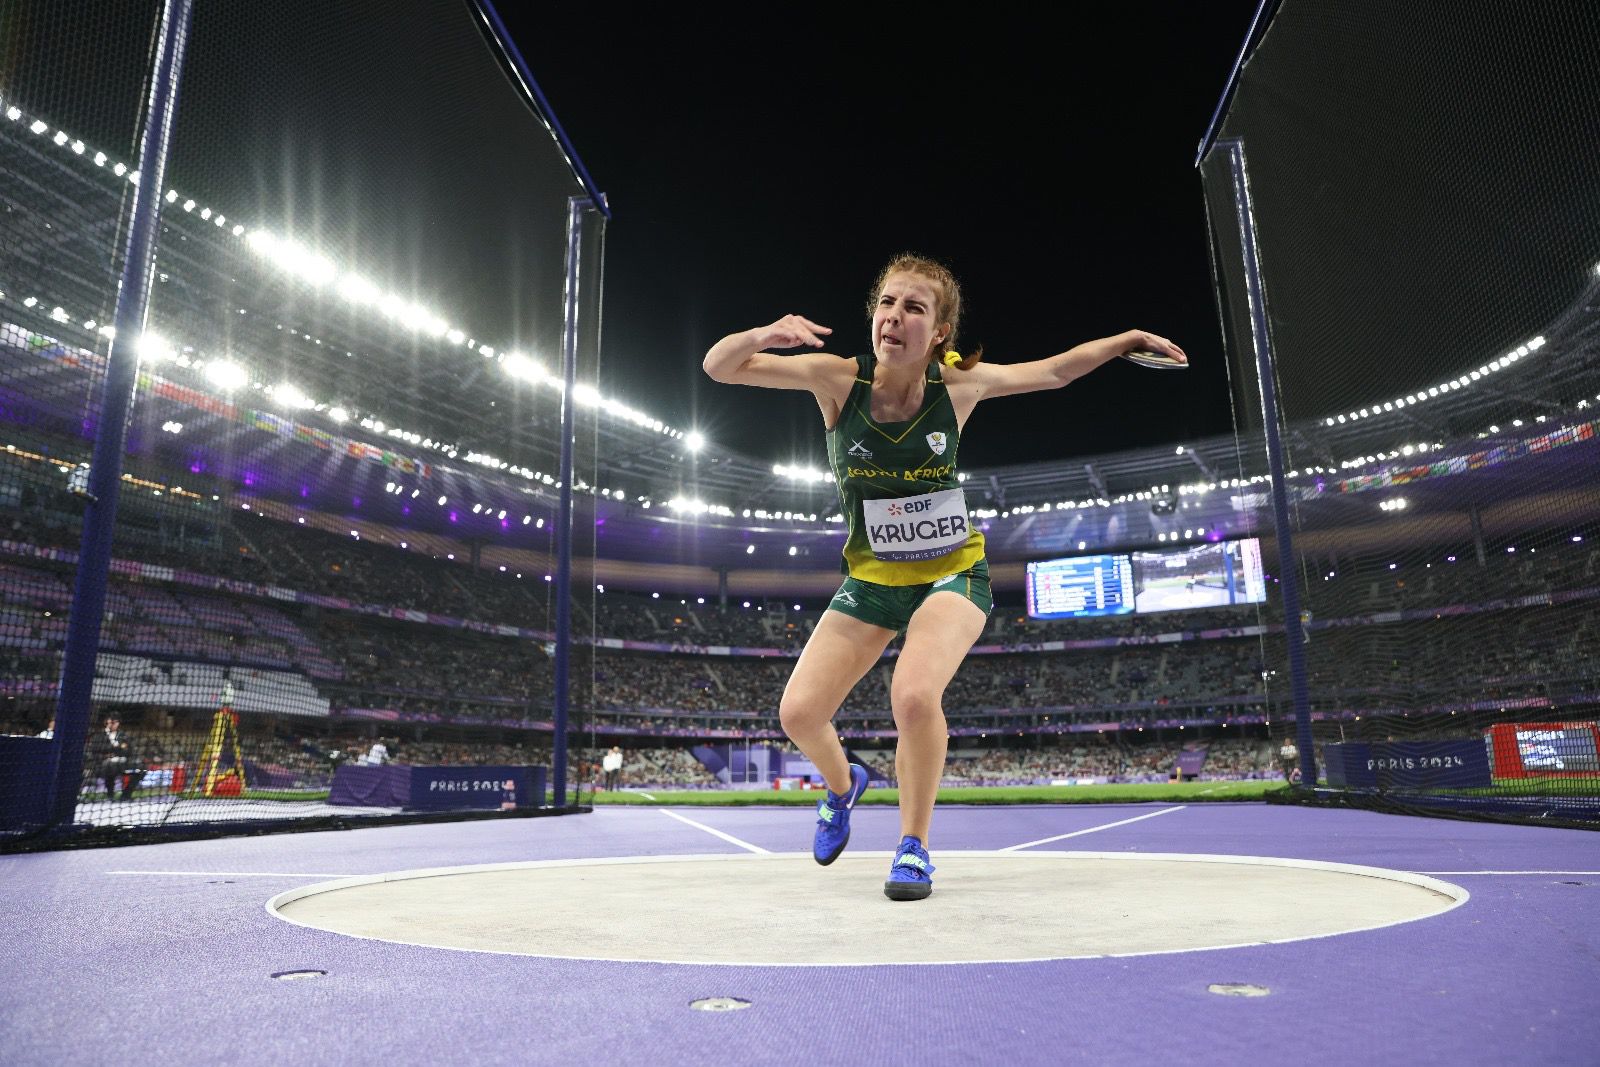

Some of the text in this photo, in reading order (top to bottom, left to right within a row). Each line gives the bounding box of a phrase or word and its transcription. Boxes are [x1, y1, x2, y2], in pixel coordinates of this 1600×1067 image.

[903, 463, 951, 481] AFRICA
[870, 515, 967, 544] KRUGER
[1367, 755, 1464, 771] PARIS 2024
[429, 780, 469, 792] PARIS
[897, 853, 928, 870] NIKE
